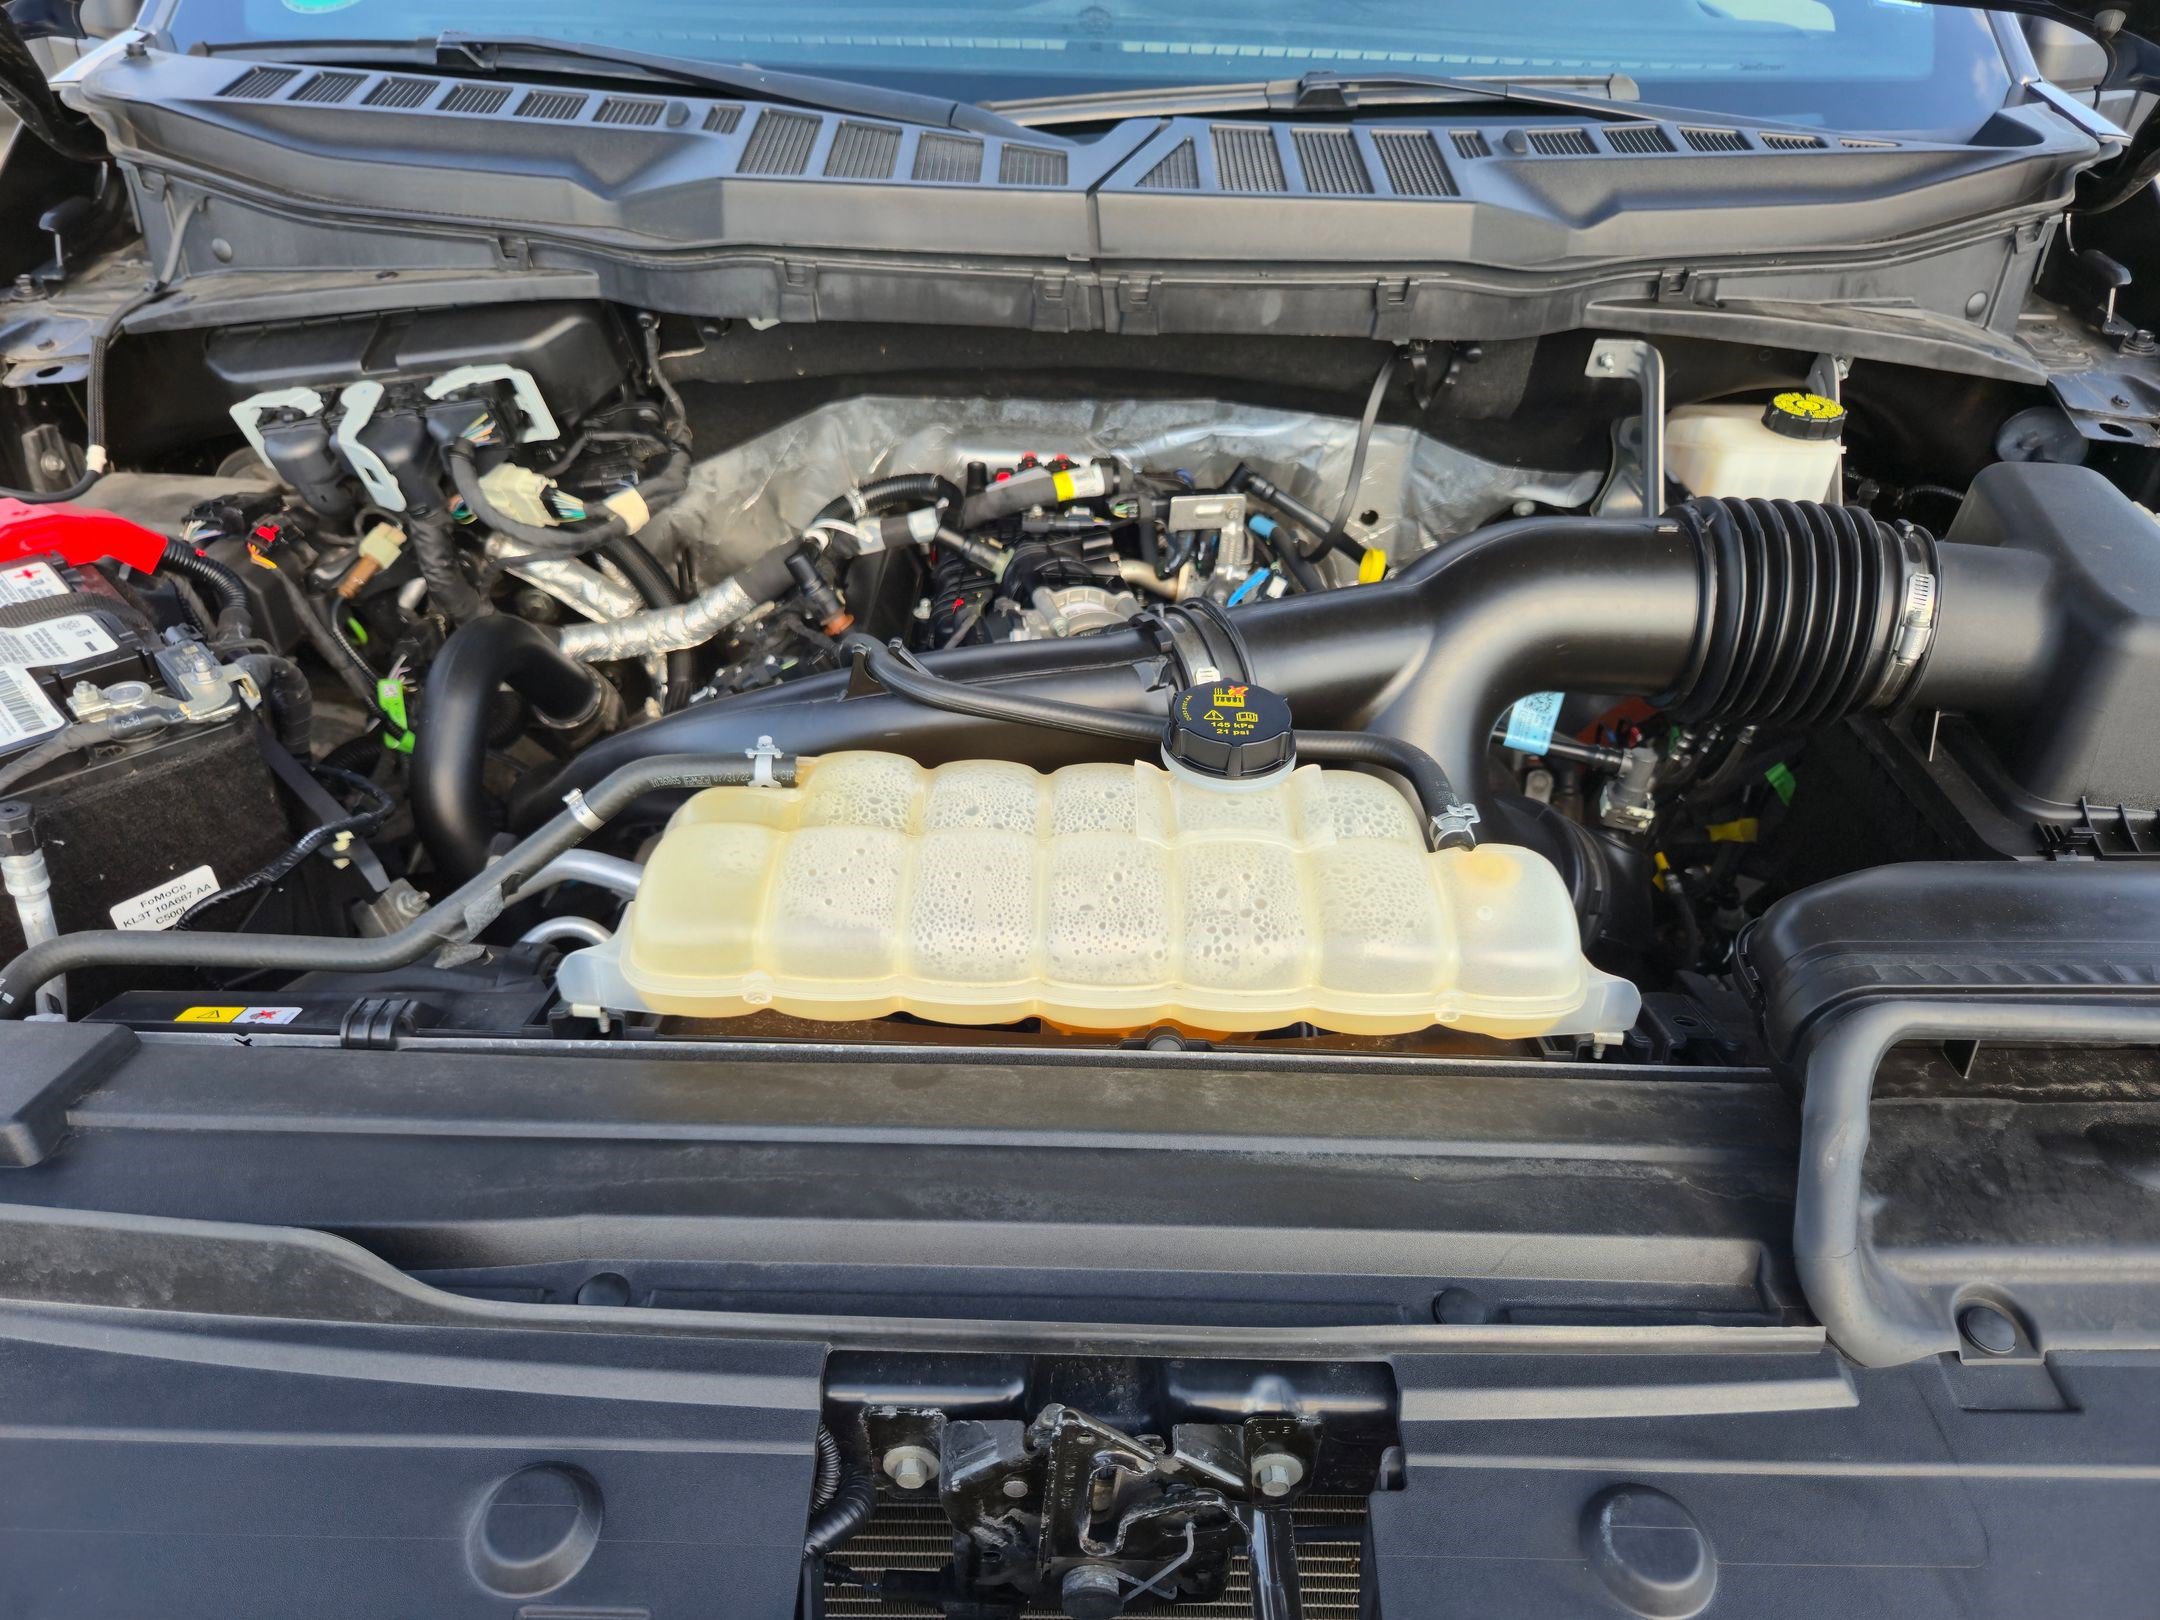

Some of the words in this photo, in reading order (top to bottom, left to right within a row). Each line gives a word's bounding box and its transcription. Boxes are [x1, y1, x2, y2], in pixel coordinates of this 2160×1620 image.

[123, 910, 152, 928] KL3T
[156, 892, 193, 913] 10A687
[196, 883, 212, 895] AA
[140, 884, 187, 908] FoMoCo
